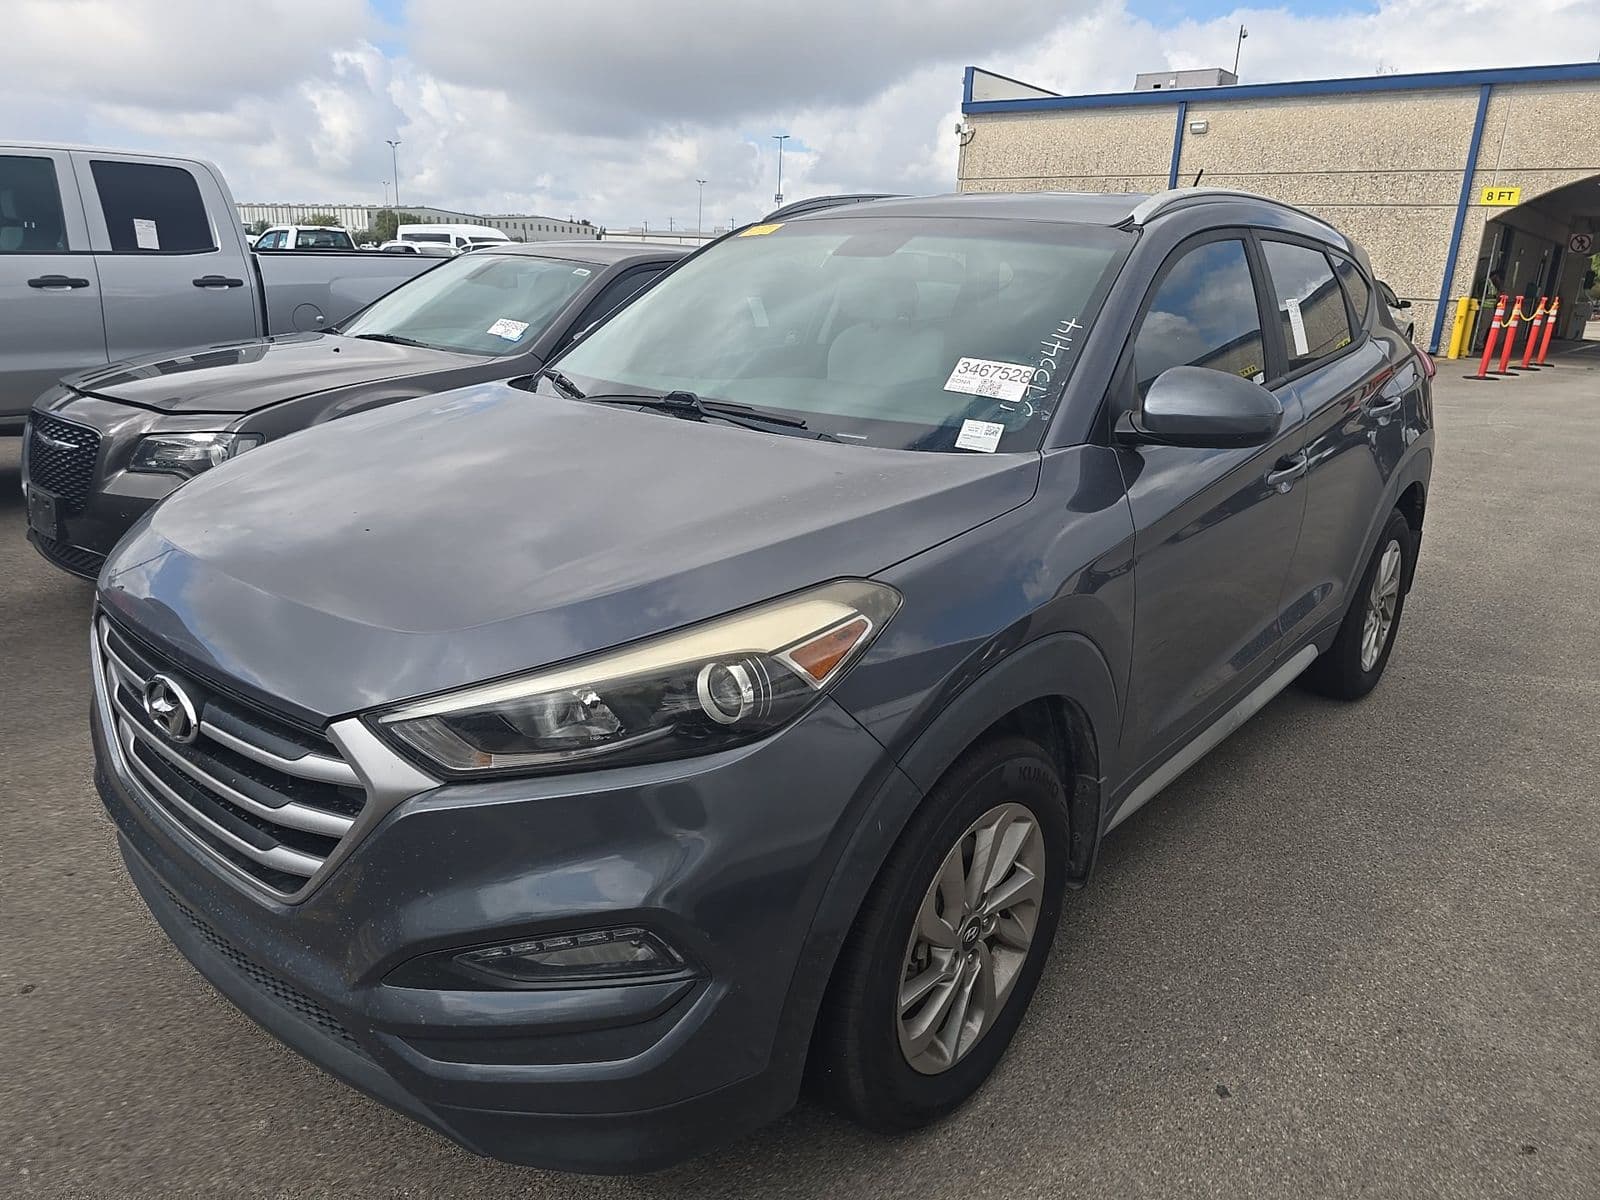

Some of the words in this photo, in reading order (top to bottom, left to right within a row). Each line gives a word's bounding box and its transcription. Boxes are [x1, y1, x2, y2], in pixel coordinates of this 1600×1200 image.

[1486, 191, 1494, 201] 8
[1497, 191, 1515, 201] FT
[957, 361, 1033, 384] 3467528
